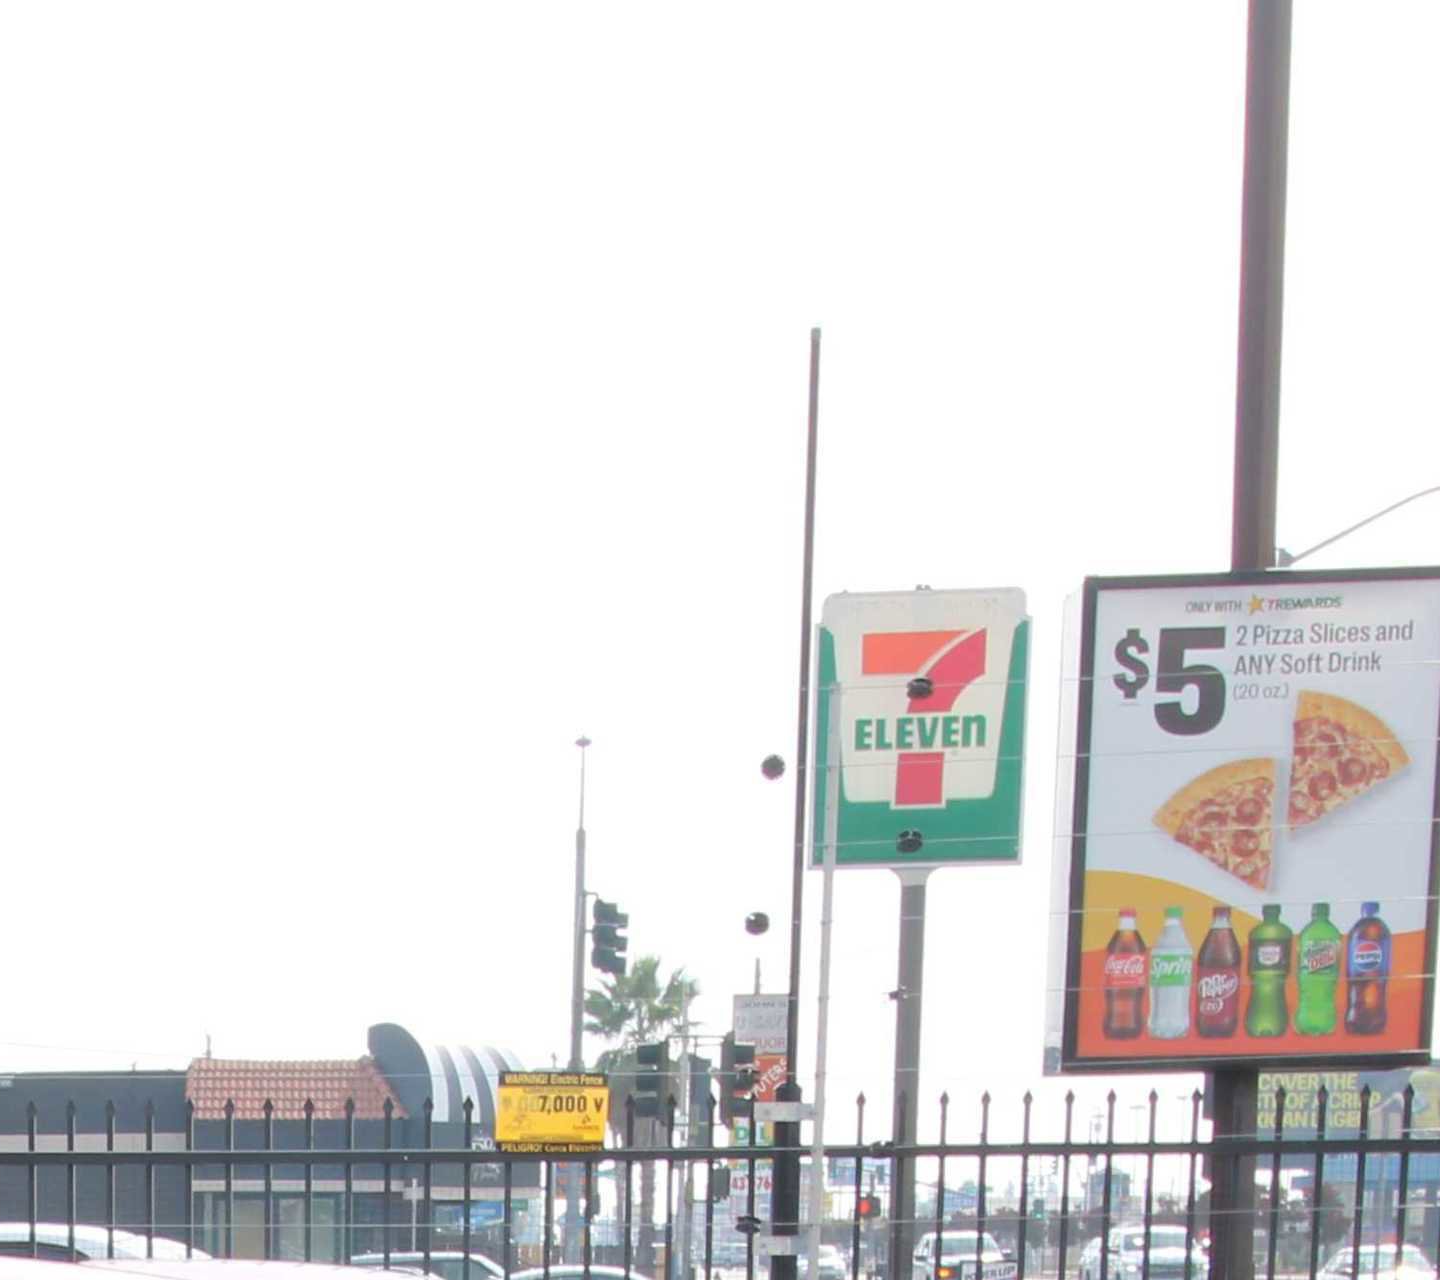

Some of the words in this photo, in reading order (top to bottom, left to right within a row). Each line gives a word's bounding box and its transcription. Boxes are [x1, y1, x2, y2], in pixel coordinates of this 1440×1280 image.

[1185, 601, 1213, 613] ONLY
[1214, 600, 1242, 612] WITH
[1236, 624, 1248, 646] 2
[1253, 624, 1304, 646] Pizza
[1309, 621, 1370, 644] Slices
[1375, 620, 1414, 642] and
[1234, 653, 1278, 676] ANY
[1280, 652, 1323, 674] Soft
[1328, 650, 1382, 673] Drink
[1112, 626, 1227, 736] $5
[1232, 684, 1260, 701] (20
[1262, 683, 1290, 699] oz.)
[538, 1095, 587, 1115] 7,000
[593, 1097, 604, 1113] V
